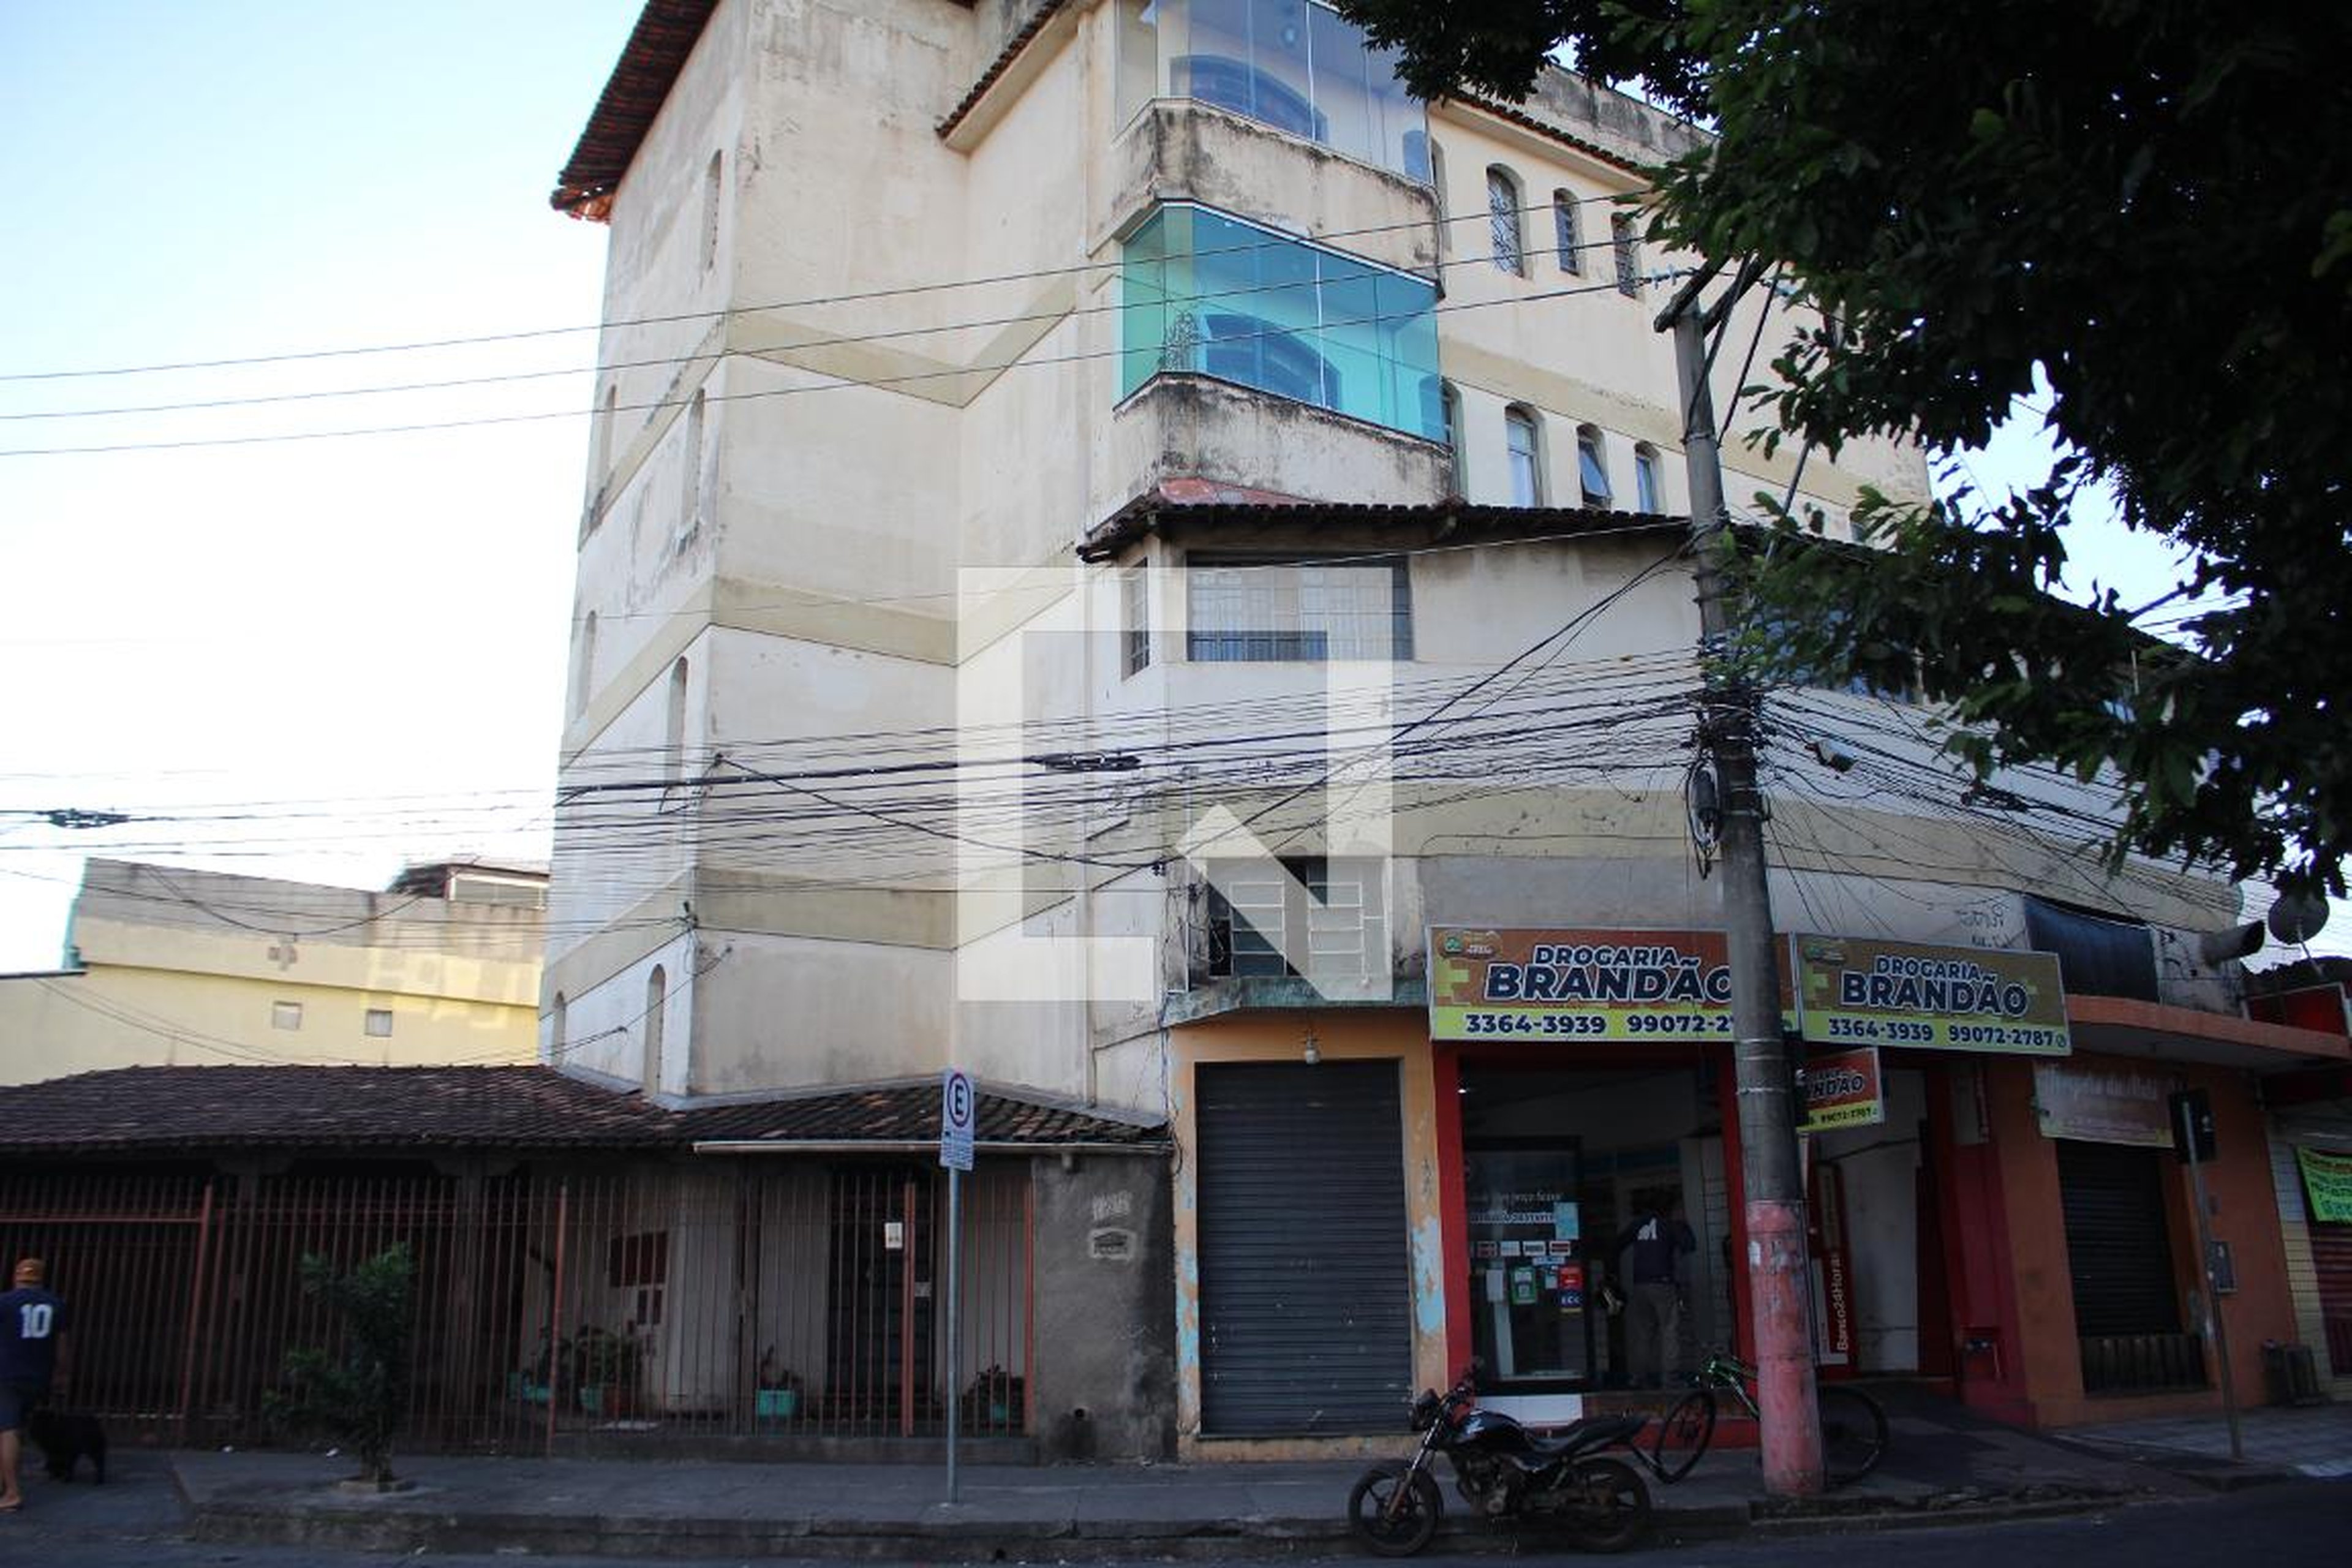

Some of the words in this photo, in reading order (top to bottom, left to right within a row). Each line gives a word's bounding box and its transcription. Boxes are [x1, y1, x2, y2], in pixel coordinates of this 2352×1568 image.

[1534, 945, 1679, 967] DROGARIA
[1875, 956, 1980, 980] DROGARIA
[1485, 957, 1732, 1003] BRANDÃO
[1841, 973, 2028, 1017] BRANDÃO
[1466, 1015, 1607, 1035] 3364-3939
[1627, 1015, 1733, 1033] 99072-2
[1829, 1019, 1934, 1041] 3364-3939
[1949, 1026, 2054, 1047] 99072-2787
[956, 1085, 964, 1115] E
[20, 1304, 53, 1338] 10
